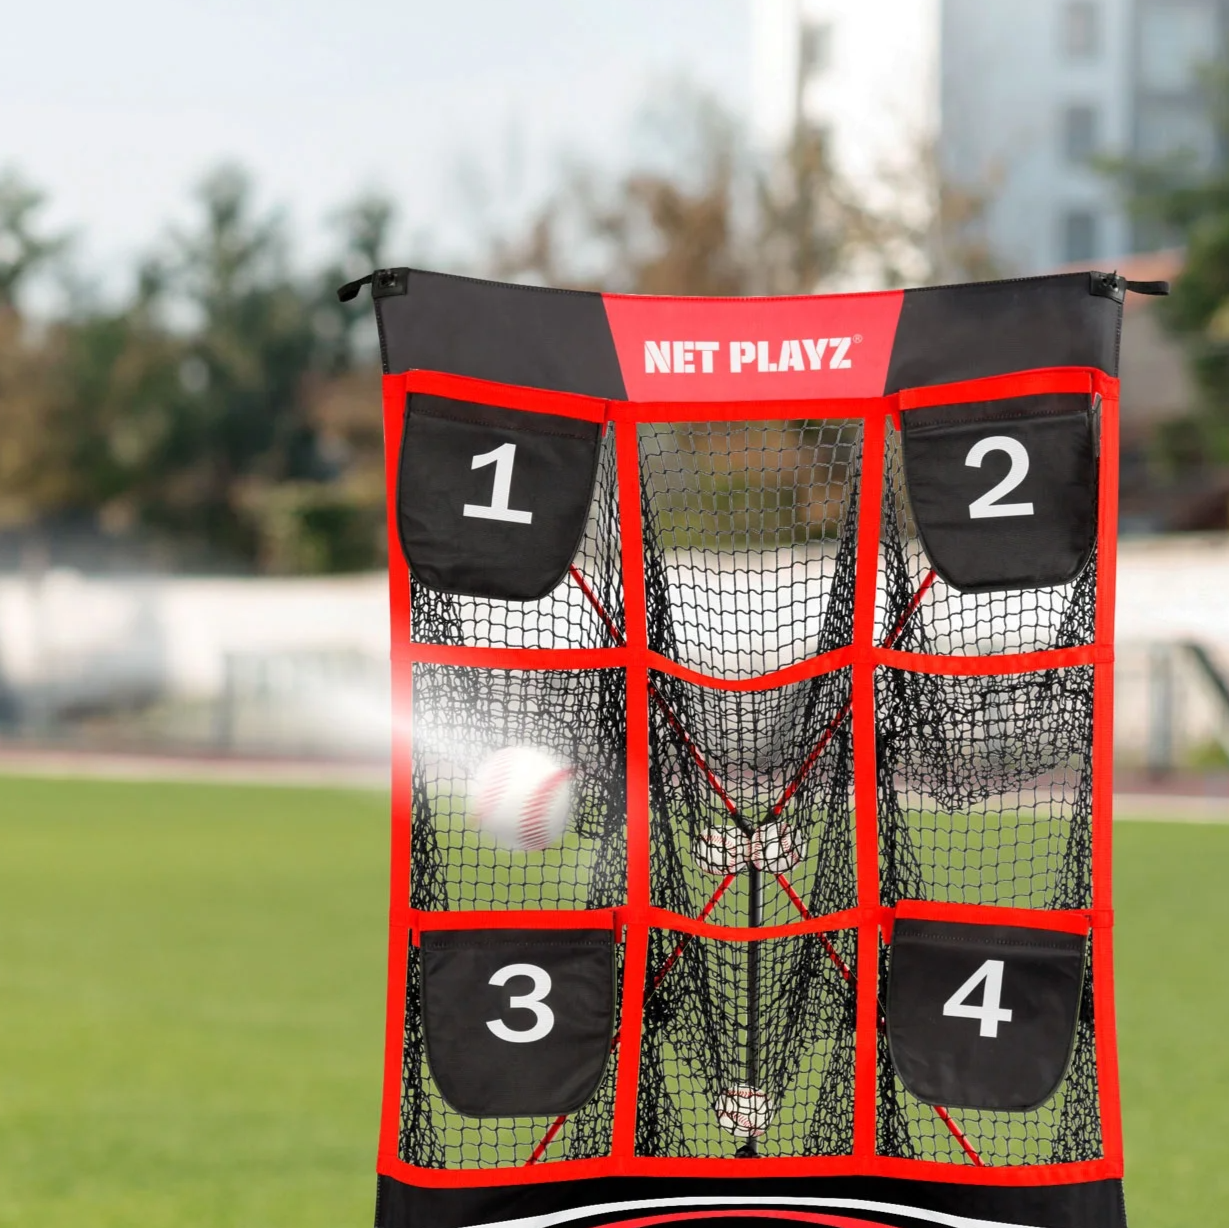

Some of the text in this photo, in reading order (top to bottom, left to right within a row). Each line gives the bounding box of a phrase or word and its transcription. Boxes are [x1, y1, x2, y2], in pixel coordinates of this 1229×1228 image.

[644, 340, 720, 373] NET
[462, 442, 533, 525] 1
[964, 435, 1035, 519] 2
[485, 963, 555, 1043] 3
[942, 959, 1013, 1038] 4
